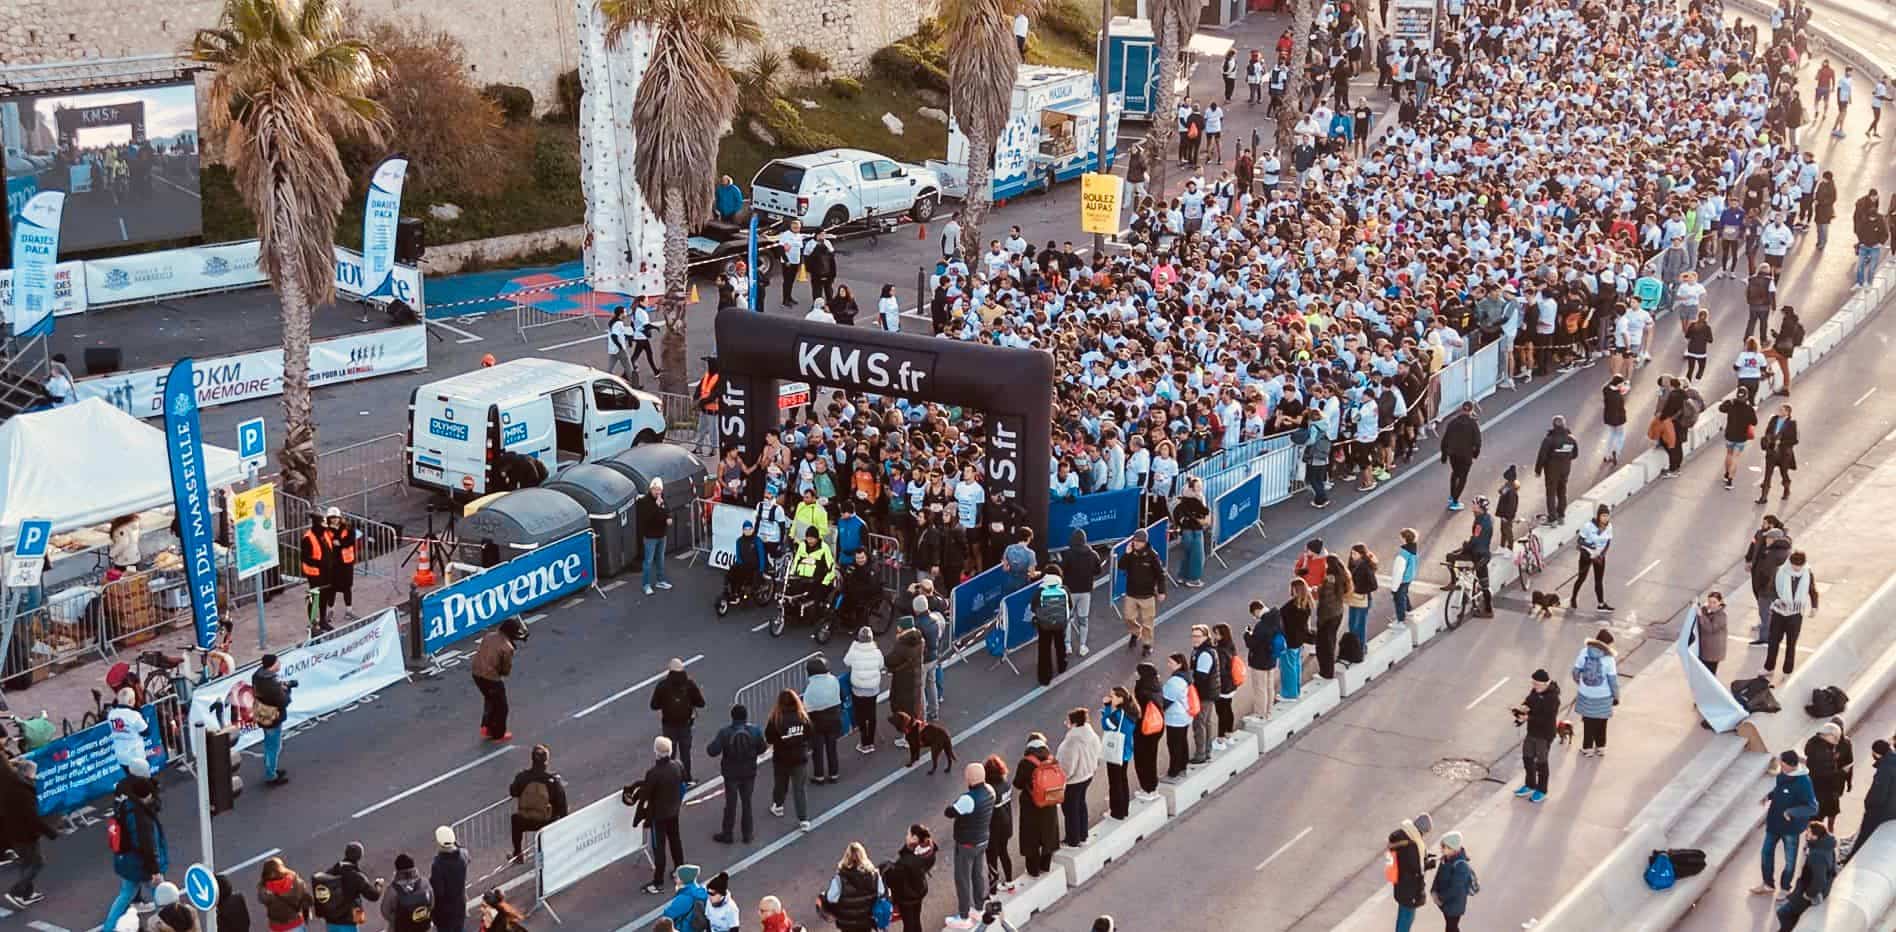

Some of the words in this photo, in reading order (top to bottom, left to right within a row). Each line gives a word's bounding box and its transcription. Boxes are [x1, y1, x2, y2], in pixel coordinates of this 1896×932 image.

[82, 109, 120, 122] KMS.fr
[1083, 192, 1115, 203] ROULEZ
[1086, 202, 1096, 210] AU
[1097, 203, 1113, 211] PAS
[25, 244, 49, 255] PACA
[798, 341, 927, 393] KMS.fr
[432, 421, 466, 435] OLYMPIC
[246, 428, 257, 451] P
[177, 421, 205, 537] MARSEILLE
[24, 526, 42, 550] P
[195, 543, 212, 577] DE
[200, 580, 218, 647] VILLE
[294, 659, 310, 672] KM
